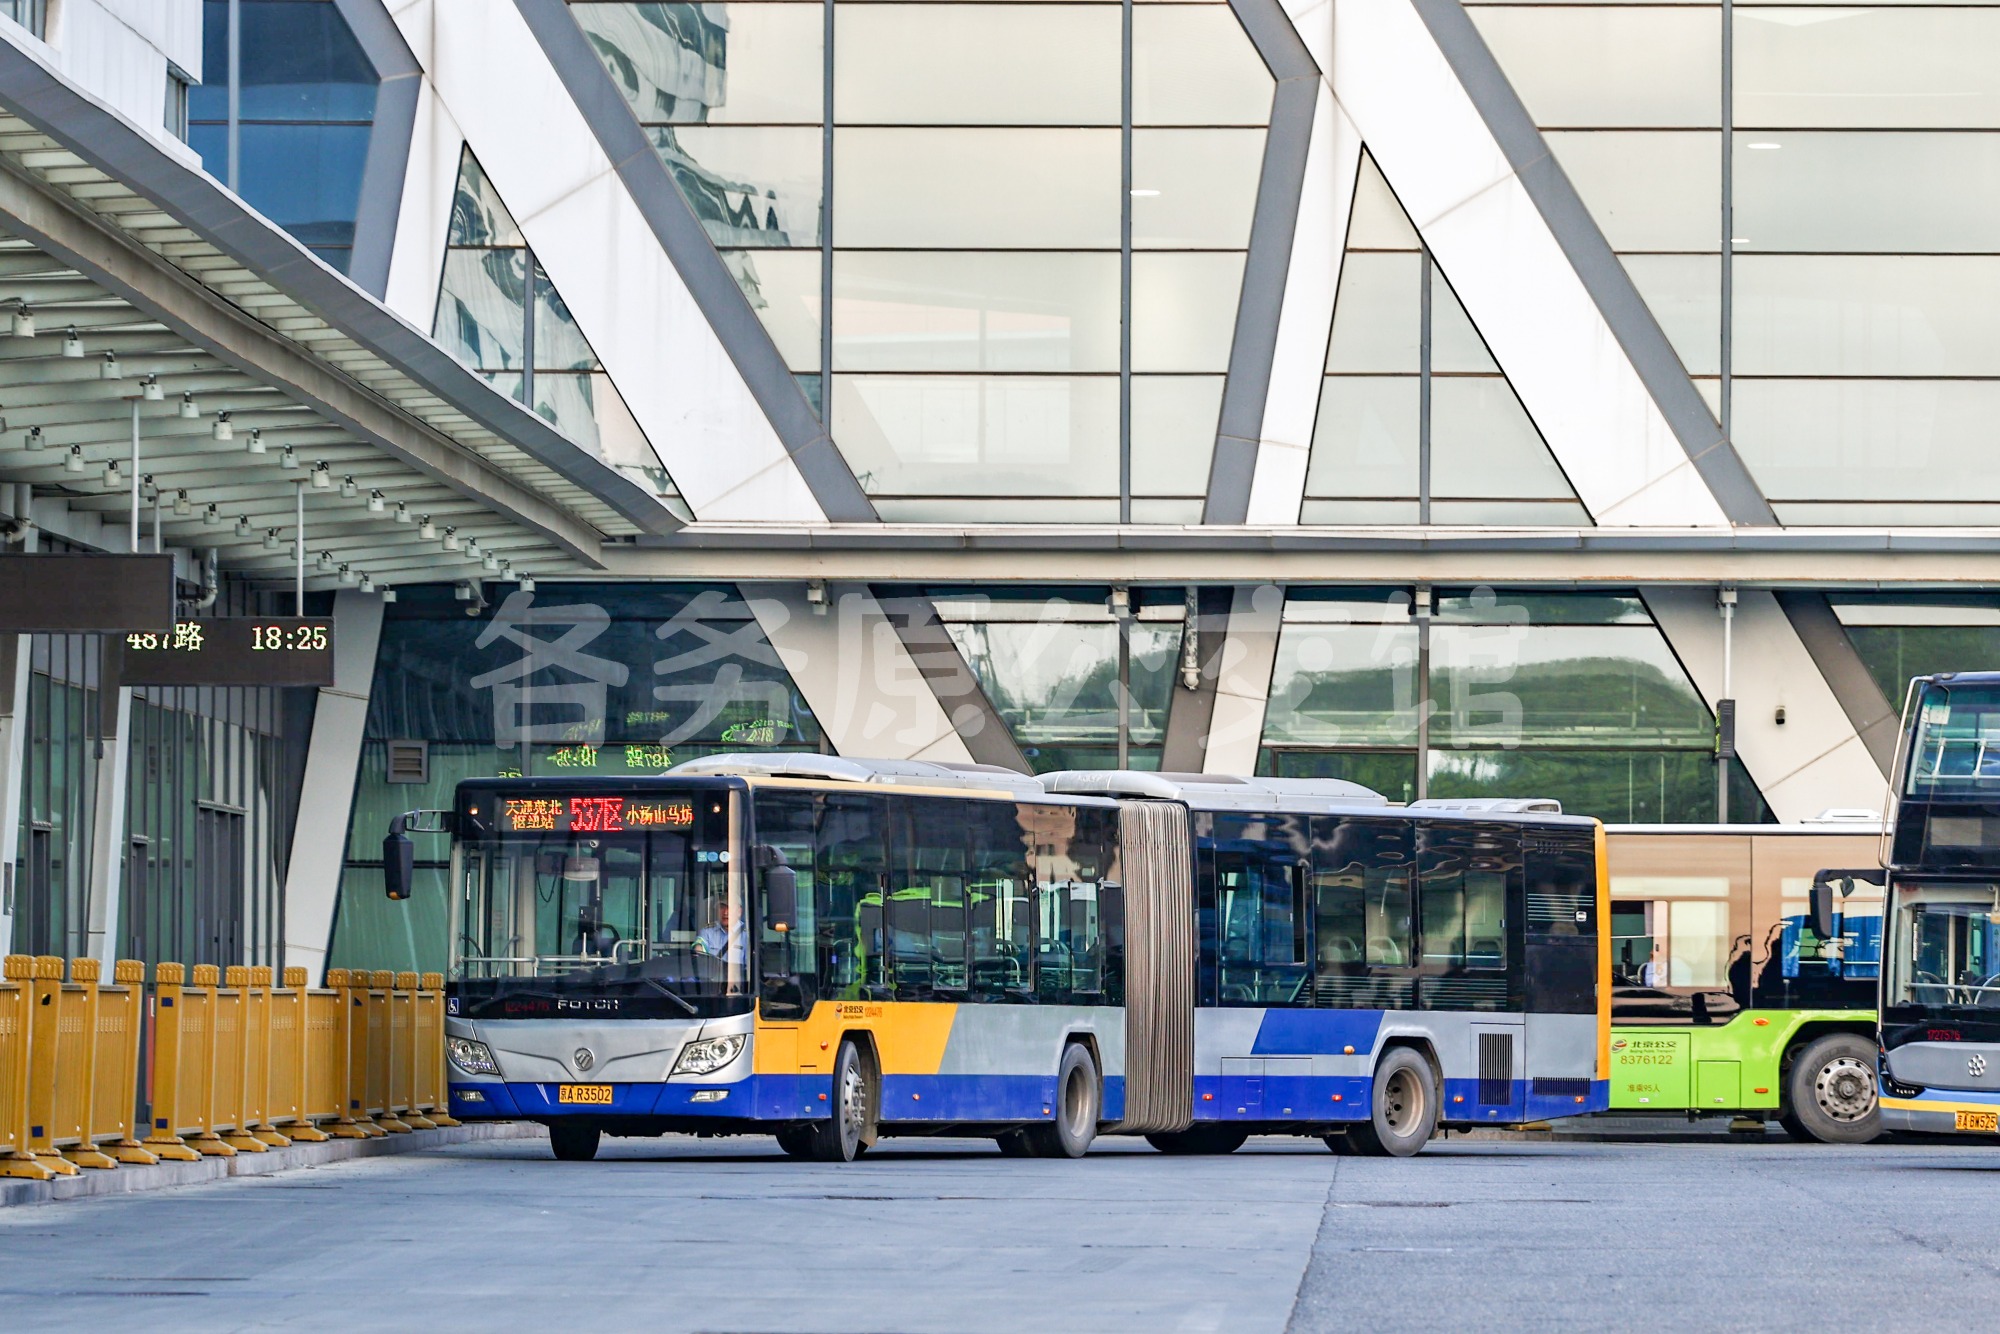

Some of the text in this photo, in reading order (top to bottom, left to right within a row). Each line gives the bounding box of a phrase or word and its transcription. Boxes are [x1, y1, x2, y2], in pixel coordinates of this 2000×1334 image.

[251, 626, 328, 650] 18:25
[505, 799, 564, 816] 天通苑北
[570, 797, 624, 831] 537区
[626, 804, 694, 826] 小汤山马坊
[511, 814, 555, 830] 枢纽站
[1620, 1055, 1673, 1065] 8376122
